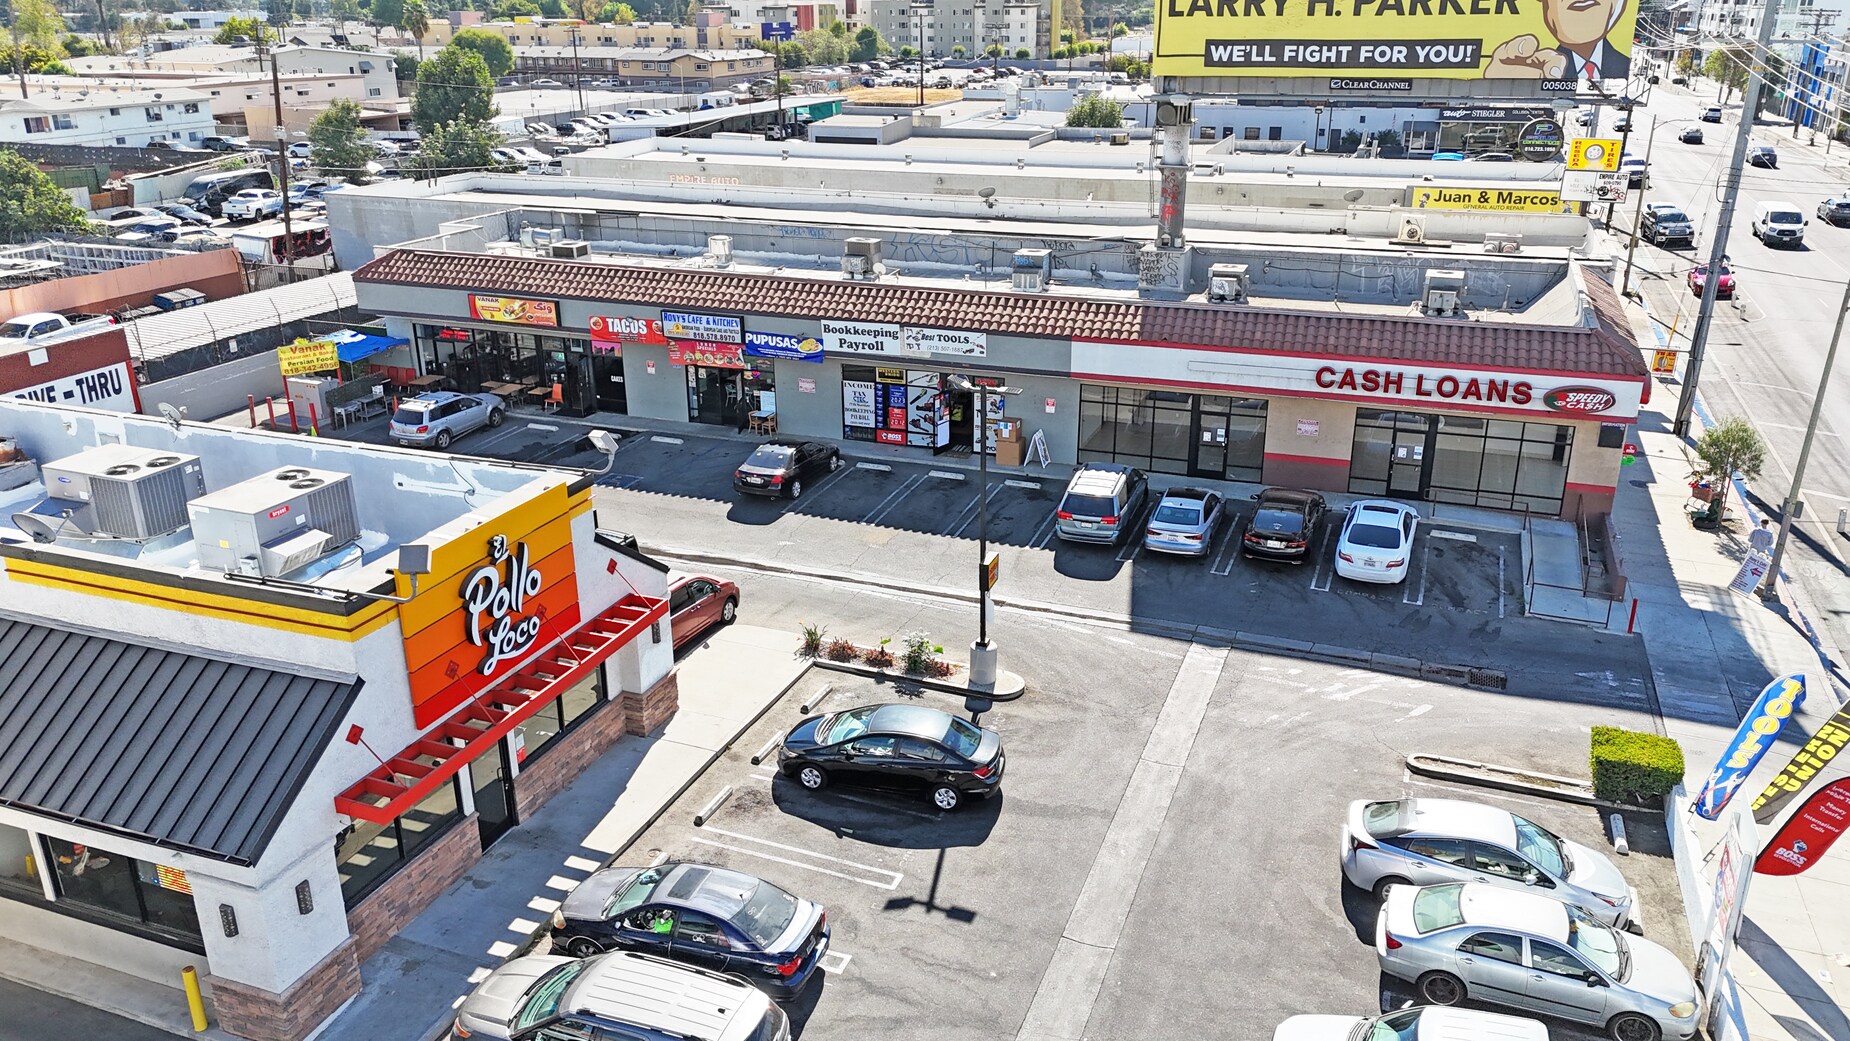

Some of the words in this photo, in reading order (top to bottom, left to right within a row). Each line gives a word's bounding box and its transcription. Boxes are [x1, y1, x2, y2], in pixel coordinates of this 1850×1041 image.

[1210, 45, 1276, 62] WE'LL
[1284, 46, 1352, 63] FIGHT
[1359, 45, 1406, 63] FOR
[1542, 81, 1577, 91] 005038
[1472, 109, 1505, 118] STIEGLER
[1571, 141, 1582, 166] RESEDA
[1605, 142, 1617, 168] TIRES
[670, 175, 707, 184] EMPIRE
[1433, 190, 1471, 204] Juan
[1478, 191, 1490, 204] &
[1497, 192, 1558, 206] Marcos
[606, 317, 647, 334] TACOS
[706, 317, 711, 325] &
[693, 332, 736, 342] 818.578.8970
[823, 324, 899, 340] Bookkeeping
[921, 333, 936, 341] Best
[937, 334, 970, 344] TOOLS
[745, 334, 799, 348] PUPUSAS
[838, 338, 884, 352] Payroll
[290, 343, 326, 354] Vanak
[288, 359, 314, 367] Persian
[75, 368, 122, 404] THRU
[1315, 366, 1403, 395] CASH
[1415, 373, 1533, 405] LOANS
[1566, 392, 1610, 405] SPEEDY
[270, 506, 289, 518] bryant
[464, 543, 542, 646] Pollo
[483, 615, 540, 676] Loco
[1726, 677, 1805, 769] TOOLS
[1782, 728, 1850, 792] UNION
[1820, 805, 1843, 820] Transfer
[1826, 802, 1847, 815] Money
[1810, 824, 1825, 833] Calls
[1775, 847, 1807, 865] BOSS
